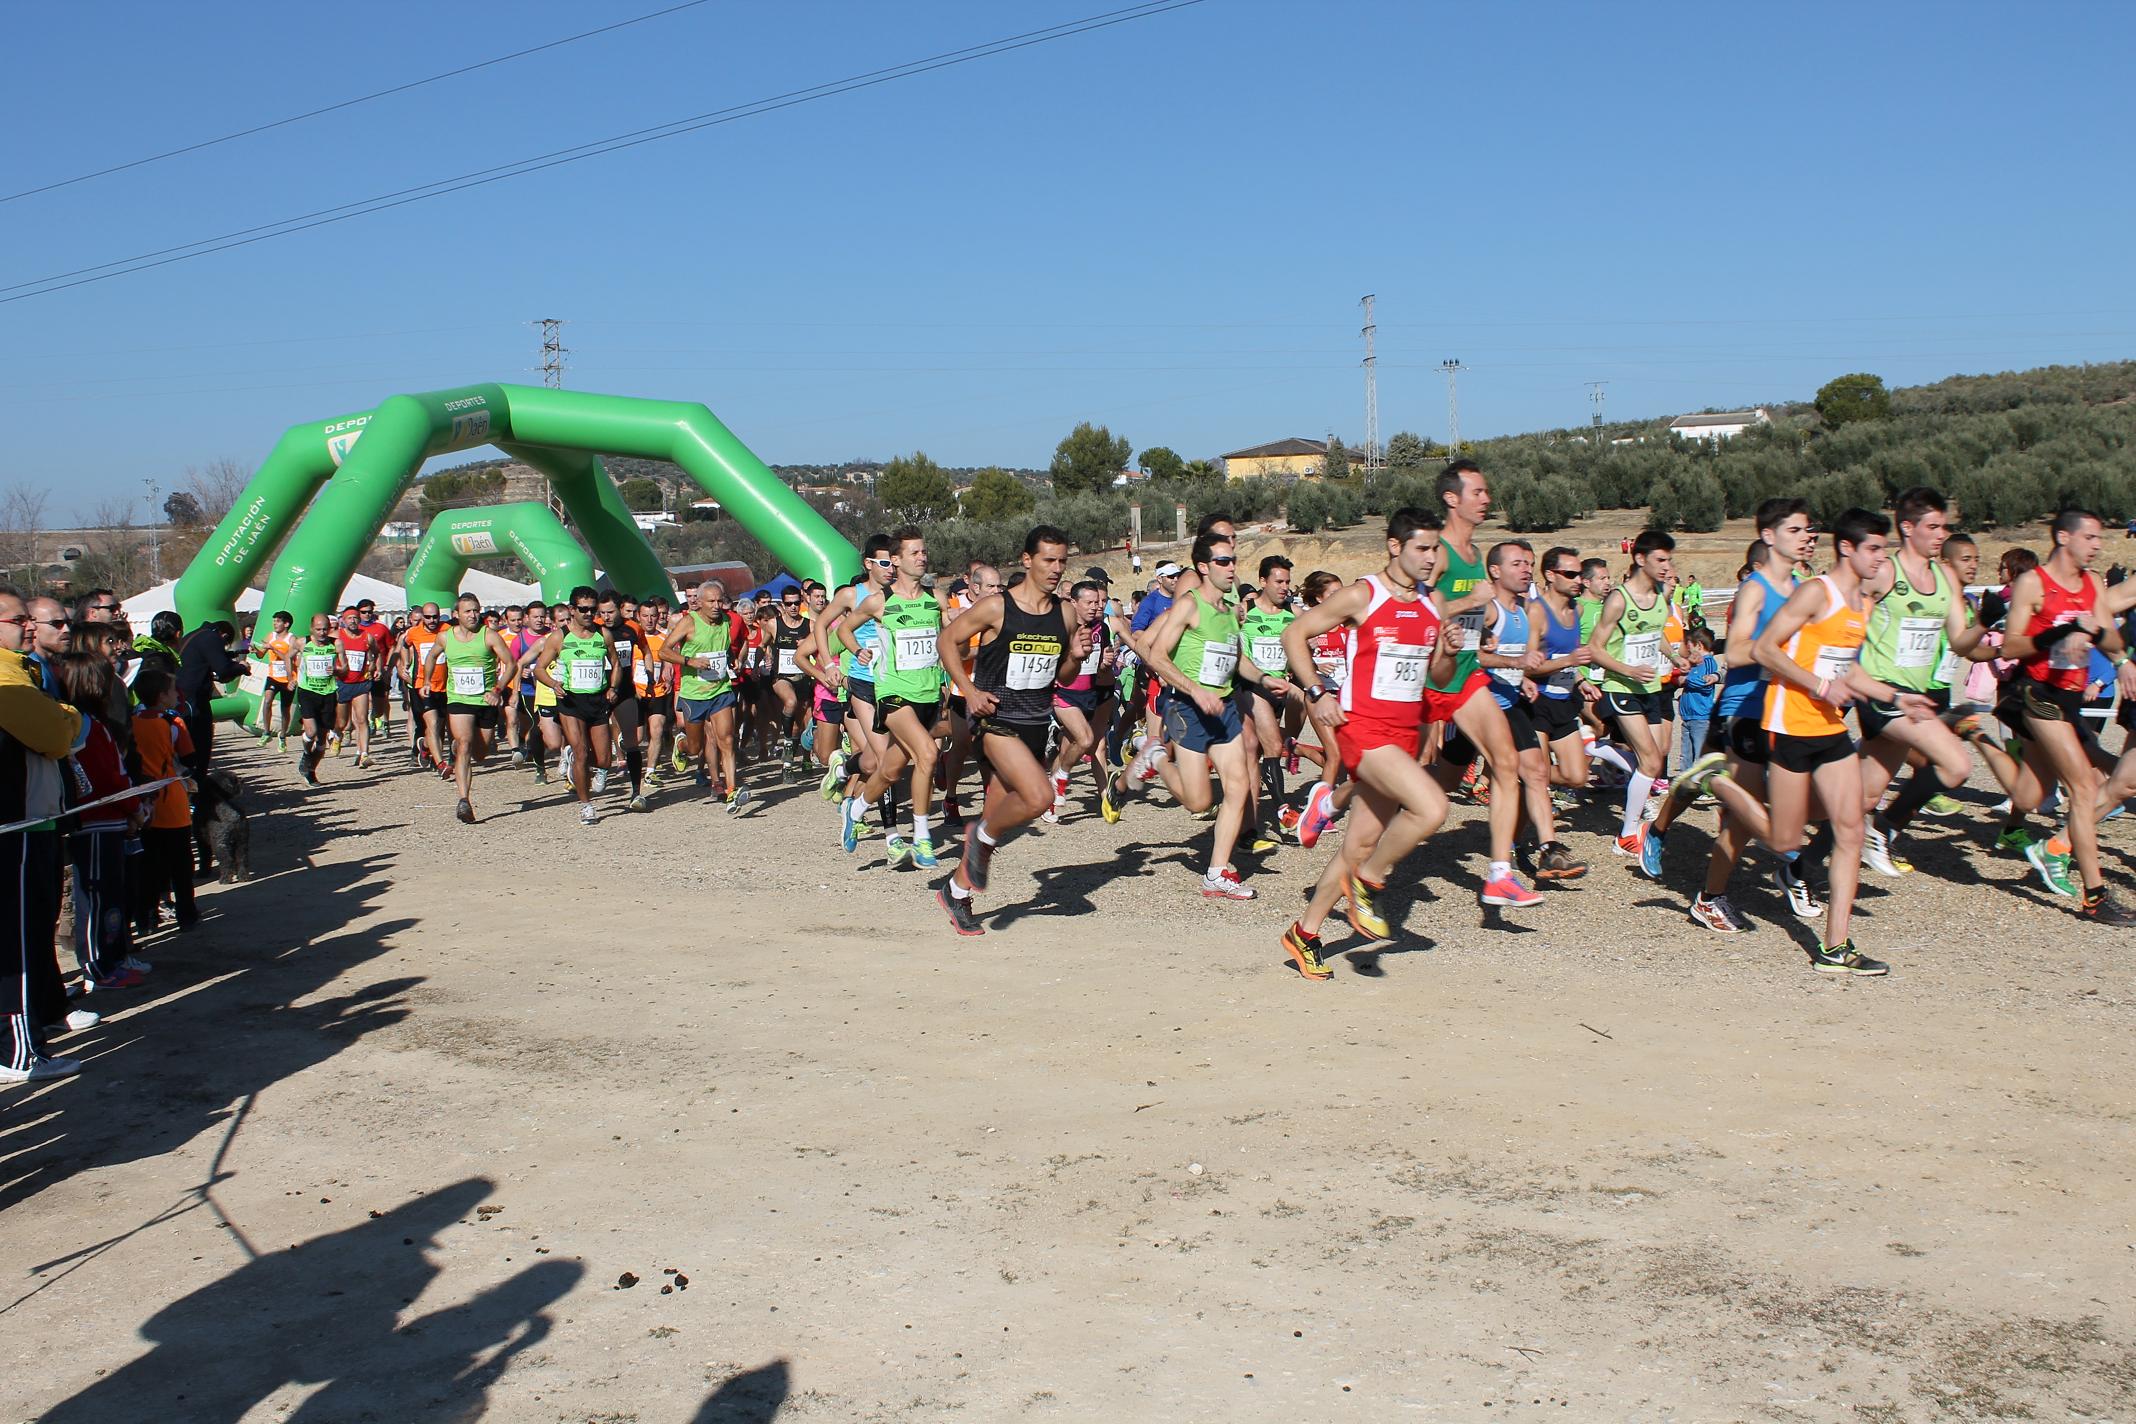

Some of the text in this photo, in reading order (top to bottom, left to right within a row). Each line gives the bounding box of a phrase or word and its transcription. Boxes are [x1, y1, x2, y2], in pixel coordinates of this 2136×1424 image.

[445, 396, 486, 411] DEPORTES
[324, 415, 372, 434] DEPO
[468, 417, 488, 437] Jaén
[215, 495, 266, 566] DIPUTACIÓN
[451, 520, 492, 529] DEPORTES
[233, 514, 271, 564] DE JAÉN
[468, 536, 493, 550] Jaén
[409, 536, 436, 585] DEPORTES
[508, 530, 547, 576] DEPORTES
[1016, 633, 1057, 641] skechers
[906, 640, 932, 655] 1213
[1261, 647, 1284, 659] 1212
[1021, 656, 1051, 673] 1454
[1394, 661, 1419, 681] 985
[460, 675, 476, 686] 646
[579, 668, 598, 679] 1186
